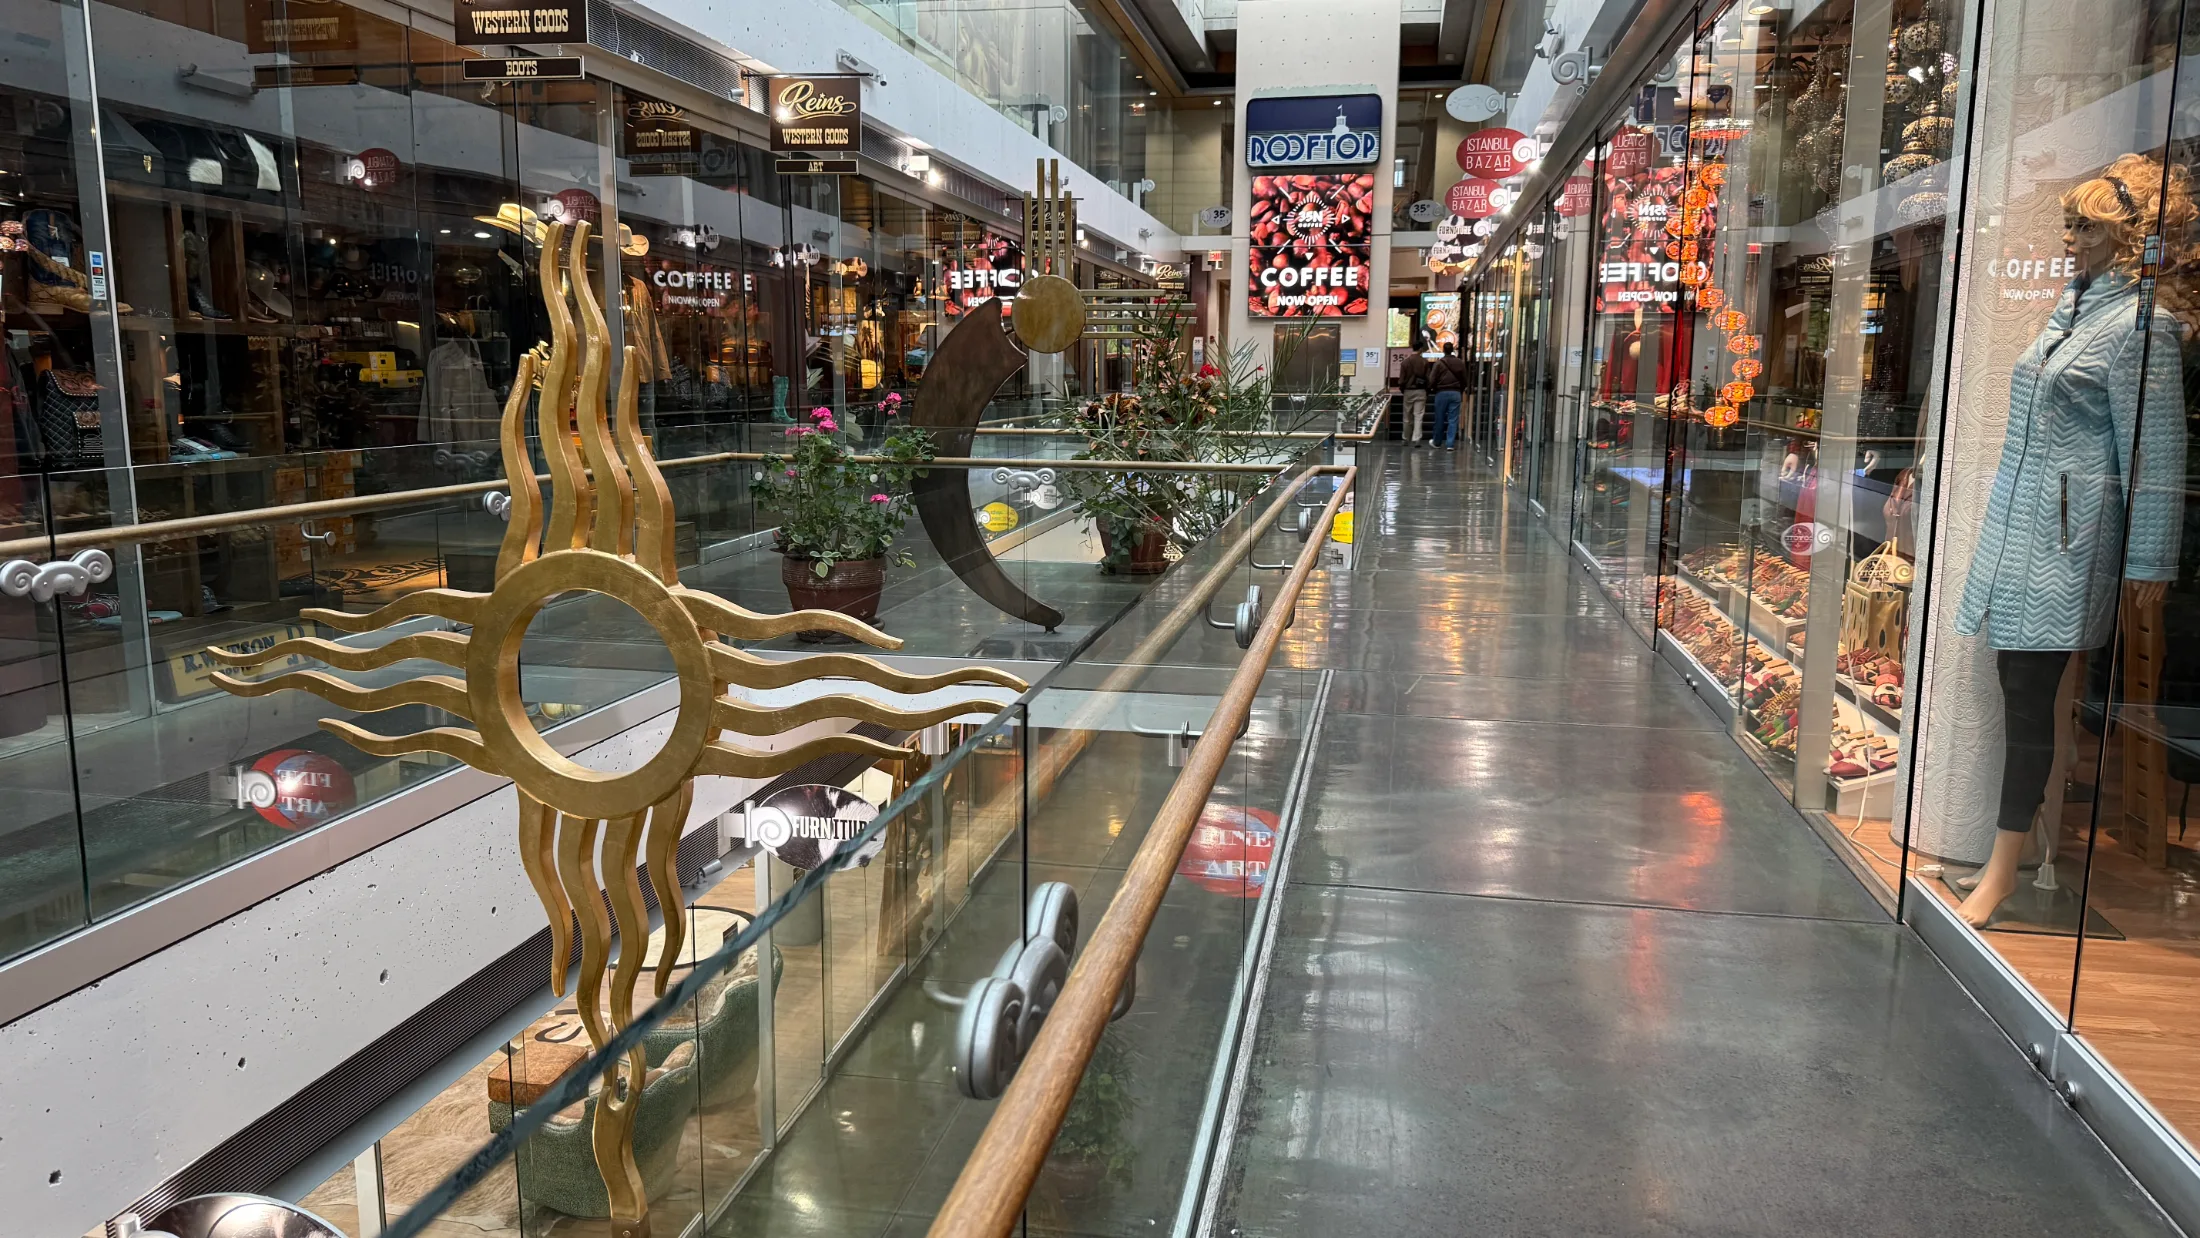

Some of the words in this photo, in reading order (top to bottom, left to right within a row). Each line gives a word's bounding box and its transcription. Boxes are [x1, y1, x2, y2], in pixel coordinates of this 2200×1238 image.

[471, 10, 531, 34] WESTERN
[534, 9, 569, 32] GOODS
[506, 60, 538, 76] BOOTS
[778, 80, 857, 119] Reins
[782, 128, 823, 145] WESTERN
[824, 128, 849, 145] GOODS
[1250, 132, 1376, 164] ROOFTOP
[1466, 138, 1511, 152] ISTANBUL
[808, 161, 824, 172] ART
[1466, 155, 1511, 170] BAZAR
[1452, 185, 1488, 197] ISTANBUL
[1452, 200, 1487, 211] BAZAR
[1260, 267, 1359, 287] COFFEE
[1276, 295, 1306, 307] NOW
[1306, 295, 1339, 307] OPEN
[1206, 859, 1266, 877] ART
